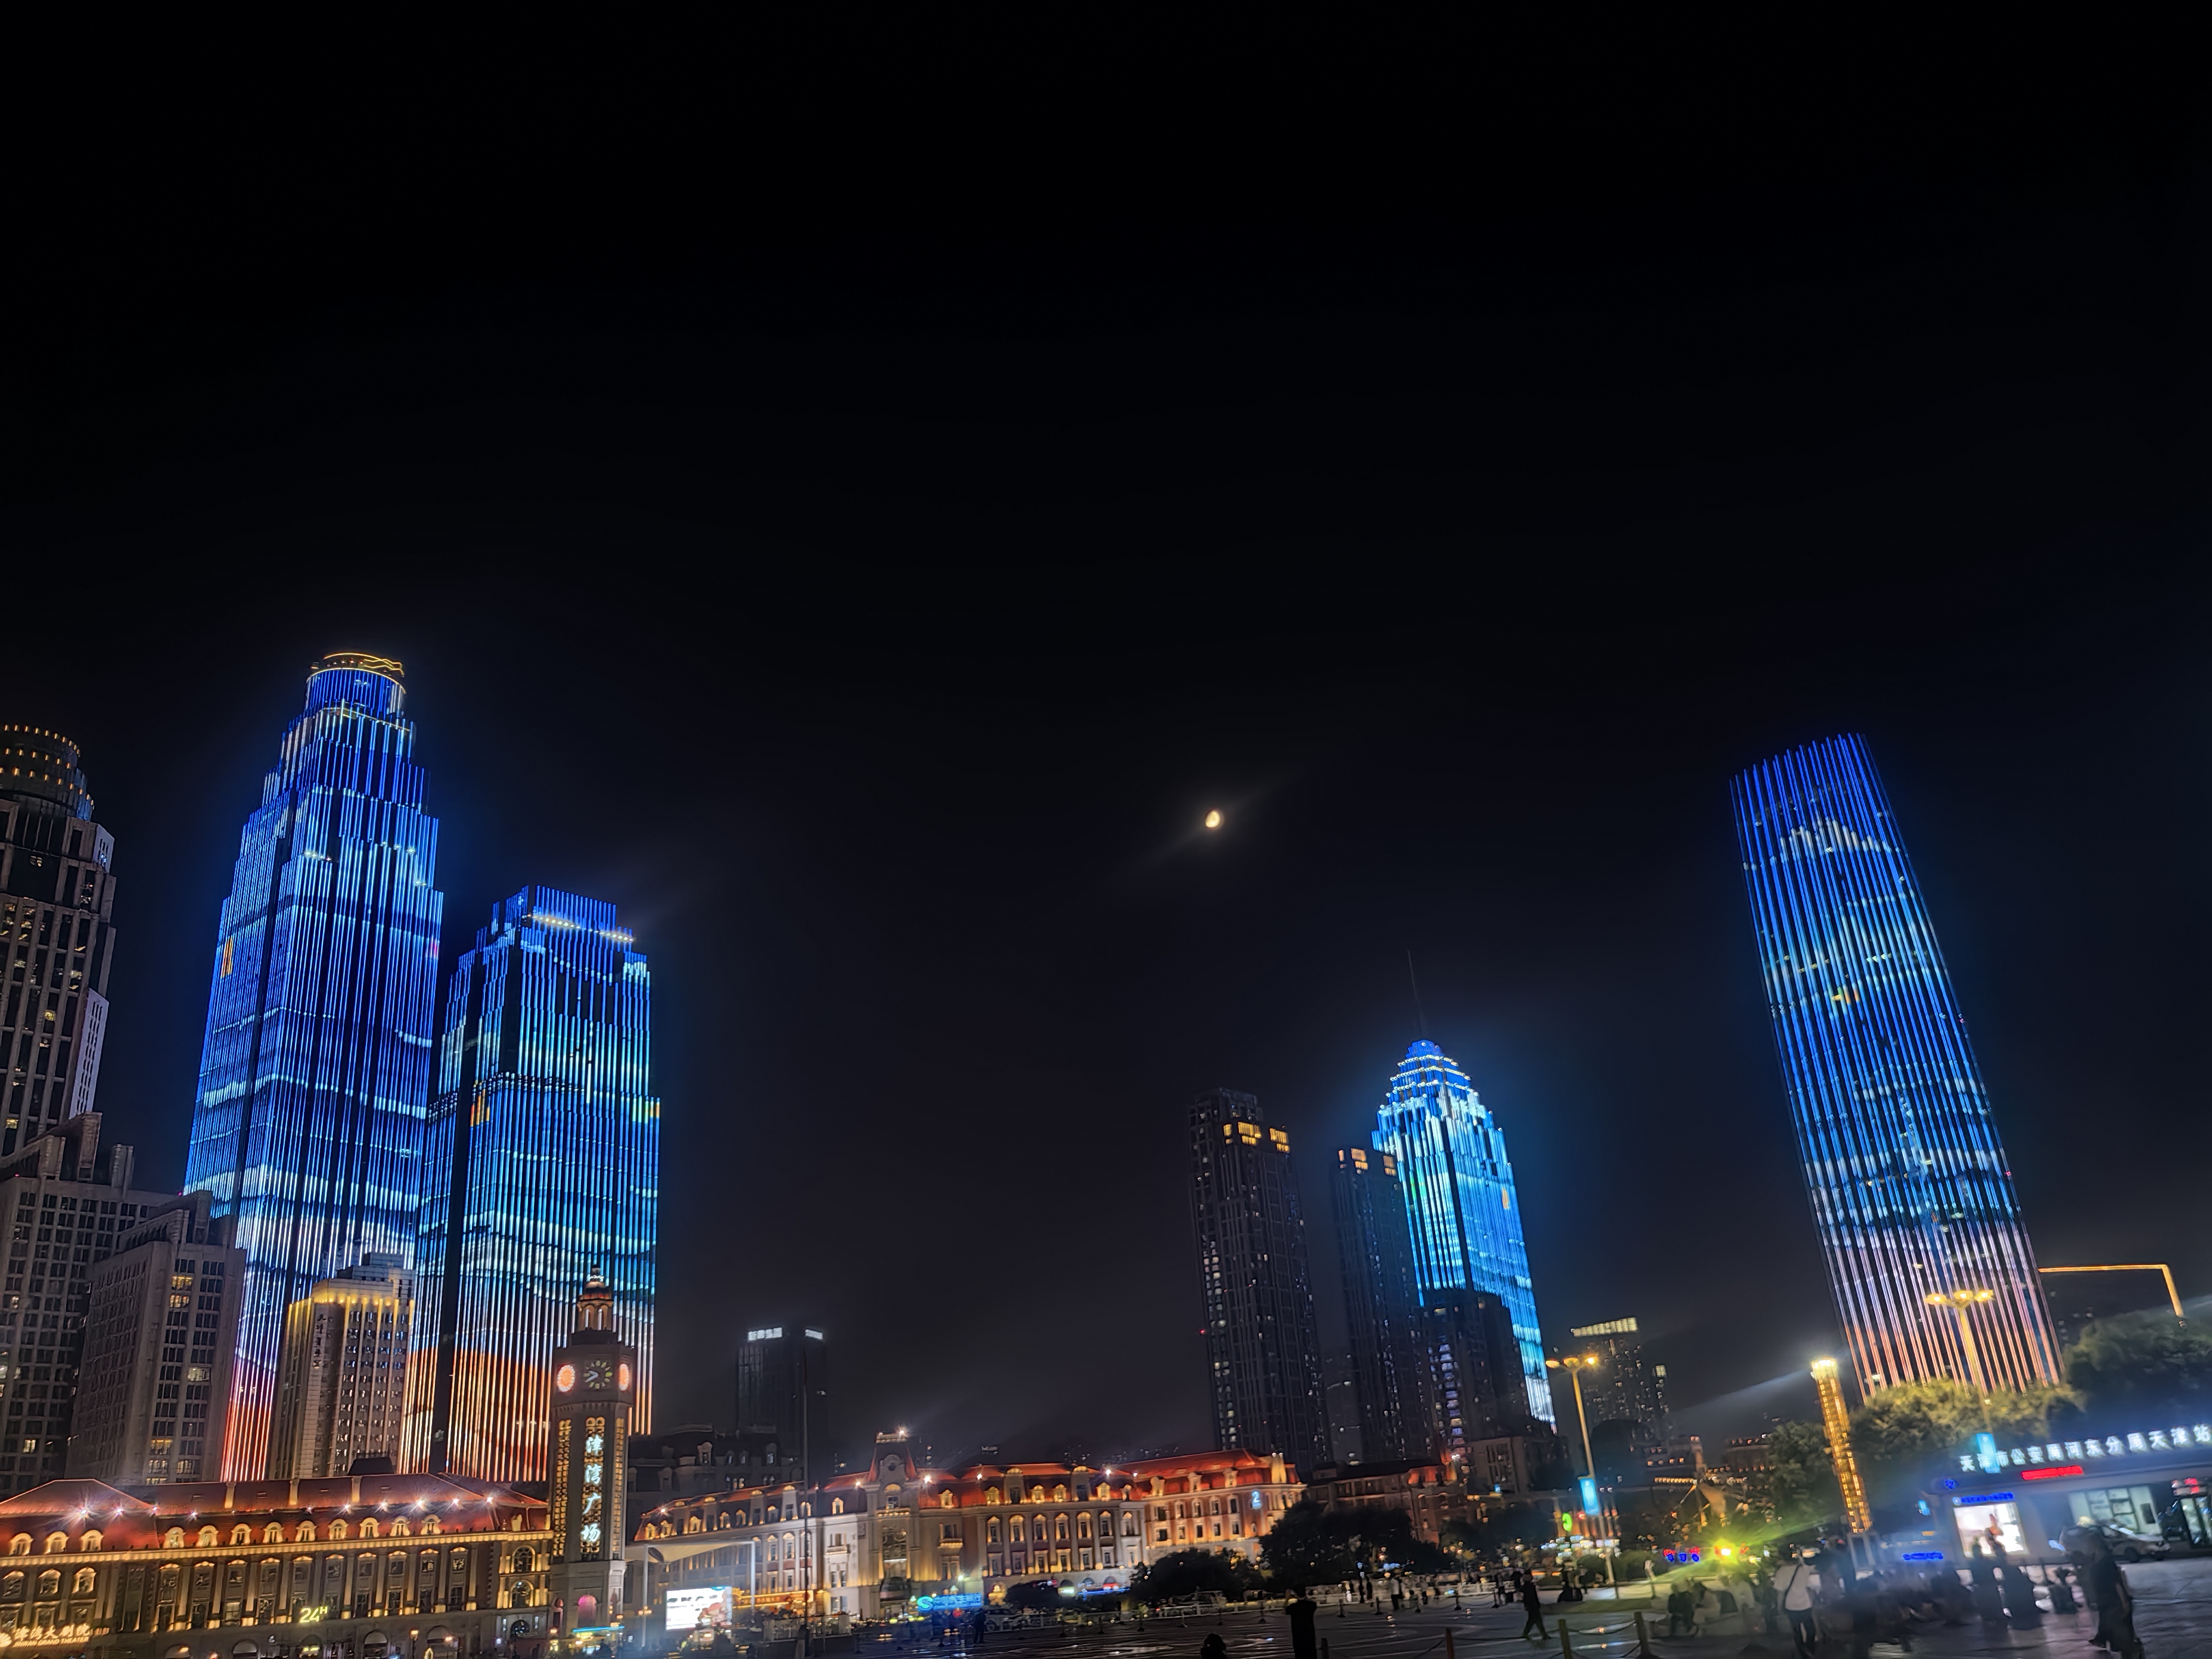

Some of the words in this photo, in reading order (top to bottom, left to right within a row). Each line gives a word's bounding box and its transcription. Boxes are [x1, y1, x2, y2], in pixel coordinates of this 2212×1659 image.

[581, 1434, 604, 1542] 津湾广场
[15, 1623, 90, 1640] 津湾大剧院
